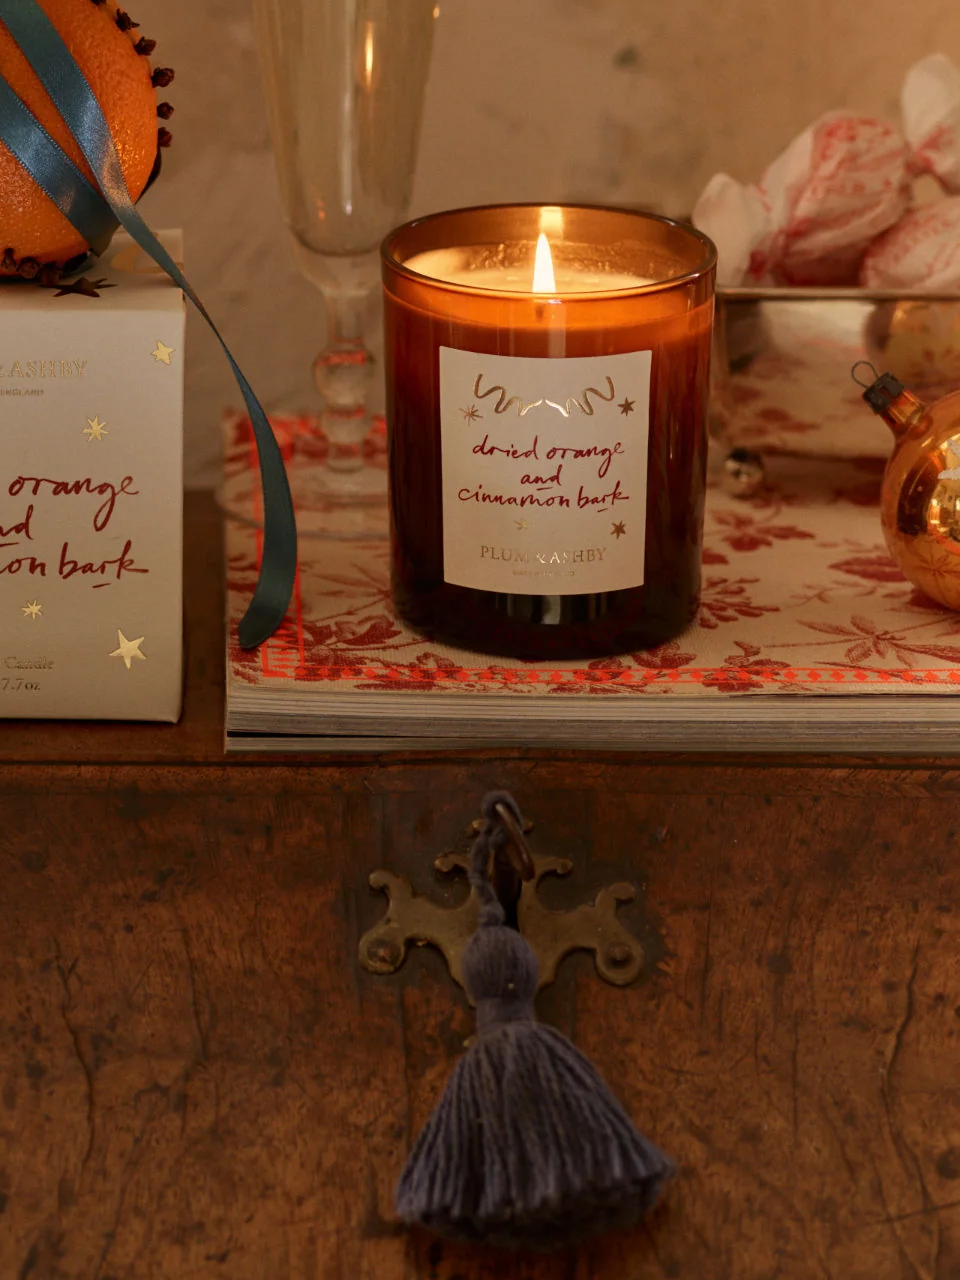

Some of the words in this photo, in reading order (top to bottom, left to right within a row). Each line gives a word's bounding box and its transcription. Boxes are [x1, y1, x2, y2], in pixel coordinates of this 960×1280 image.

[472, 434, 538, 460] dried
[546, 441, 625, 478] orange
[457, 483, 570, 508] cinnamon
[577, 480, 629, 512] bark
[520, 464, 563, 491] and
[8, 475, 140, 531] orange
[58, 540, 149, 588] bark
[4, 655, 55, 670] Candle
